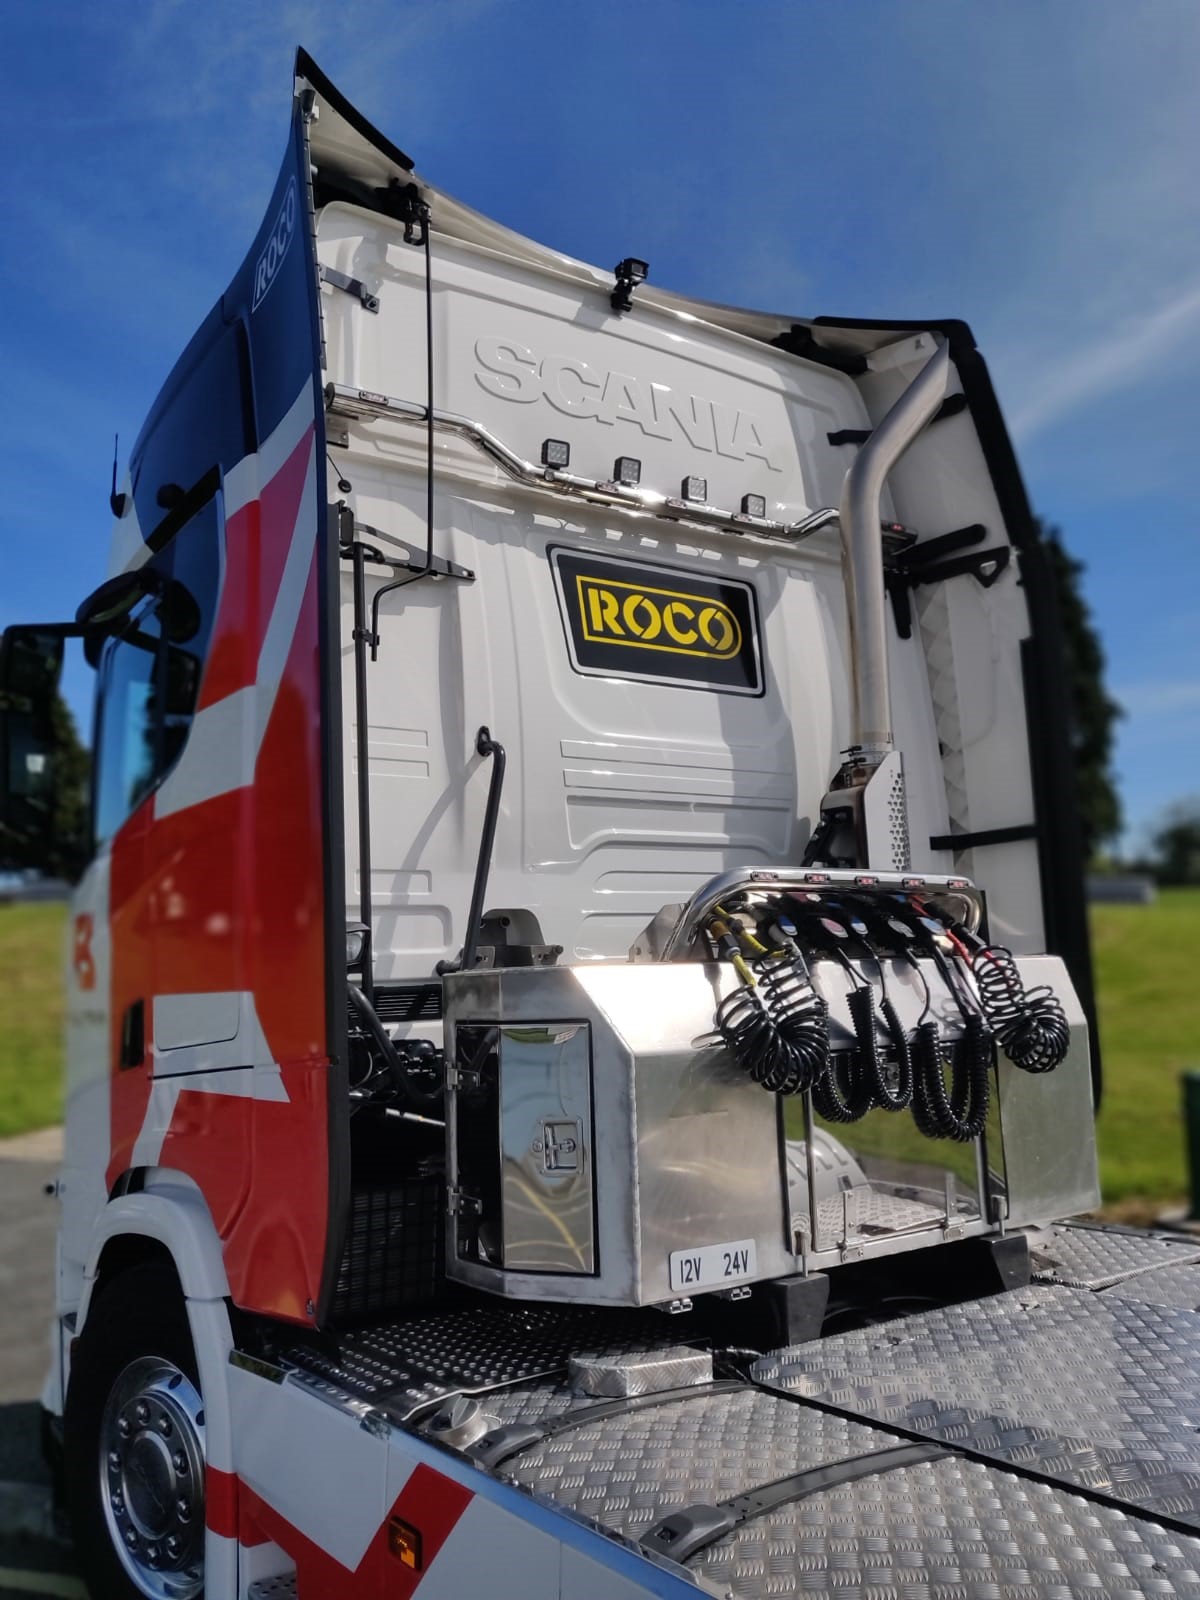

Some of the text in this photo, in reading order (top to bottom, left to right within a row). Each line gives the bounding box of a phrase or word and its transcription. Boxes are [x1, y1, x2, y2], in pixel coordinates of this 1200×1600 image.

[256, 186, 295, 300] ROCO
[474, 337, 782, 472] SCANIA
[587, 588, 734, 650] ROCO
[680, 1249, 748, 1284] 12V 24V
